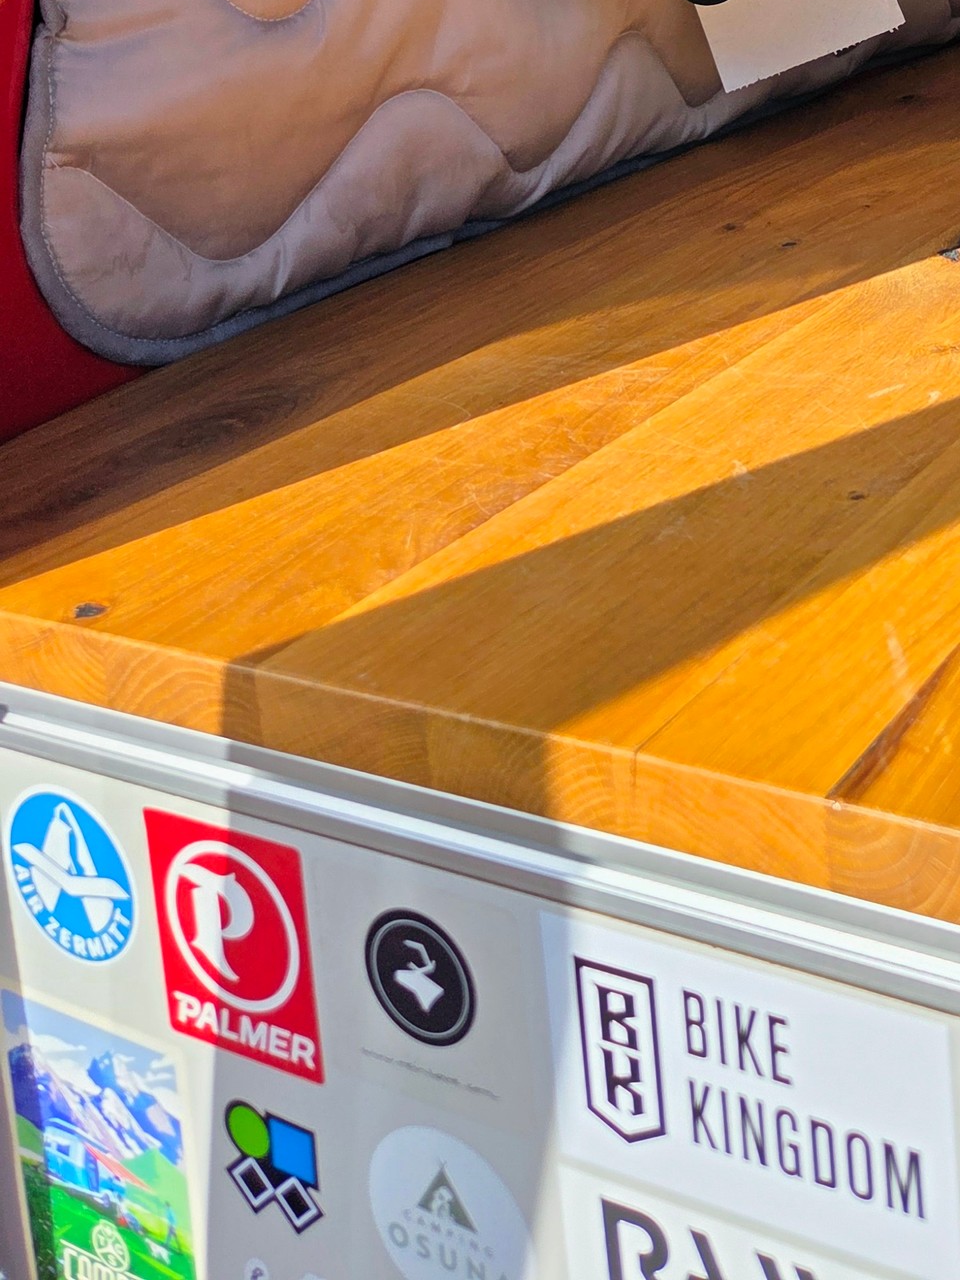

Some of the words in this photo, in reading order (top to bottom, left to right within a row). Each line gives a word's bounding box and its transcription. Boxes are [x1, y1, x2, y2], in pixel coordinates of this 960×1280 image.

[14, 863, 46, 915] AIR
[44, 906, 131, 961] ZERMATT
[172, 989, 317, 1071] PALMER
[683, 988, 793, 1087] BIKE
[689, 1080, 926, 1220] KINGDOM
